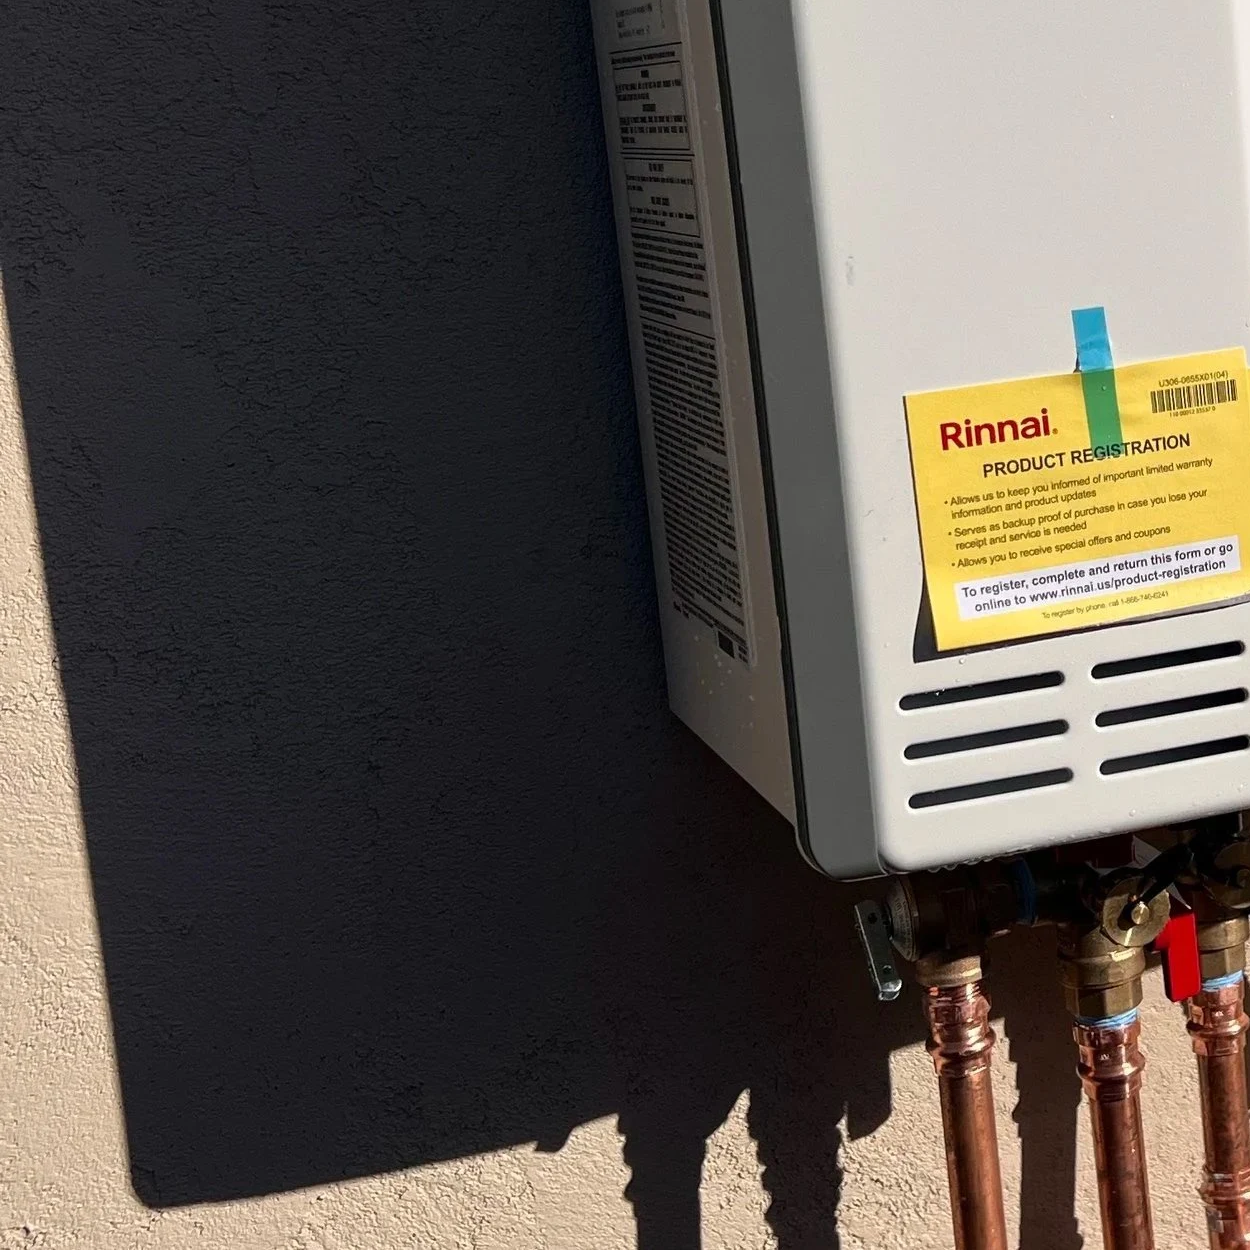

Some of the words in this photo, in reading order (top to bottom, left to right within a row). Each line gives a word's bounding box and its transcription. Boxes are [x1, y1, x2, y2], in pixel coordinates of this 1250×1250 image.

[940, 407, 1051, 451] Rinnai
[983, 452, 1066, 478] PRODUCT
[1070, 433, 1190, 465] REGISTRATION
[950, 495, 981, 507] Allows
[983, 493, 994, 502] us
[996, 490, 1006, 500] to
[1007, 487, 1030, 498] keep
[1032, 484, 1049, 496] you
[1051, 476, 1090, 491] informed
[1092, 474, 1101, 484] of
[1103, 468, 1144, 483] important
[1146, 462, 1174, 475] limited
[1176, 457, 1213, 471] warranty
[951, 503, 1002, 519] information
[1005, 500, 1022, 511] and
[1024, 495, 1059, 510] product
[1060, 489, 1097, 503] updates
[954, 525, 987, 538] Serves
[989, 523, 1001, 532] as
[1002, 517, 1036, 530] backup
[1038, 512, 1061, 526] proof
[1063, 509, 1072, 520] of
[1074, 505, 1115, 520] purchase
[1117, 502, 1125, 511] in
[1127, 499, 1148, 509] case
[1150, 496, 1166, 508] you
[1168, 493, 1186, 502] lose
[1188, 488, 1208, 501] your
[956, 538, 987, 551] receipt
[989, 534, 1007, 545] and
[1009, 529, 1041, 542] service
[1043, 527, 1051, 536] is
[1053, 521, 1087, 535] needed
[957, 556, 987, 569] Allows
[989, 554, 1006, 566] you
[1008, 550, 1018, 560] to
[1020, 545, 1052, 558] receive
[1055, 539, 1086, 554] special
[1088, 534, 1113, 547] offers
[1115, 530, 1132, 542] and
[1133, 525, 1171, 539] coupons
[961, 587, 977, 598] To
[980, 579, 1029, 596] register,
[1032, 569, 1086, 587] complete
[1088, 562, 1110, 576] and
[1113, 557, 1148, 572] return
[1150, 552, 1172, 566] this
[1174, 547, 1201, 561] form
[1204, 545, 1216, 556] or
[1218, 543, 1234, 556] go
[975, 597, 1012, 612] online
[1014, 594, 1026, 605] to
[1029, 559, 1226, 602] www.rinnai.us/product-registration
